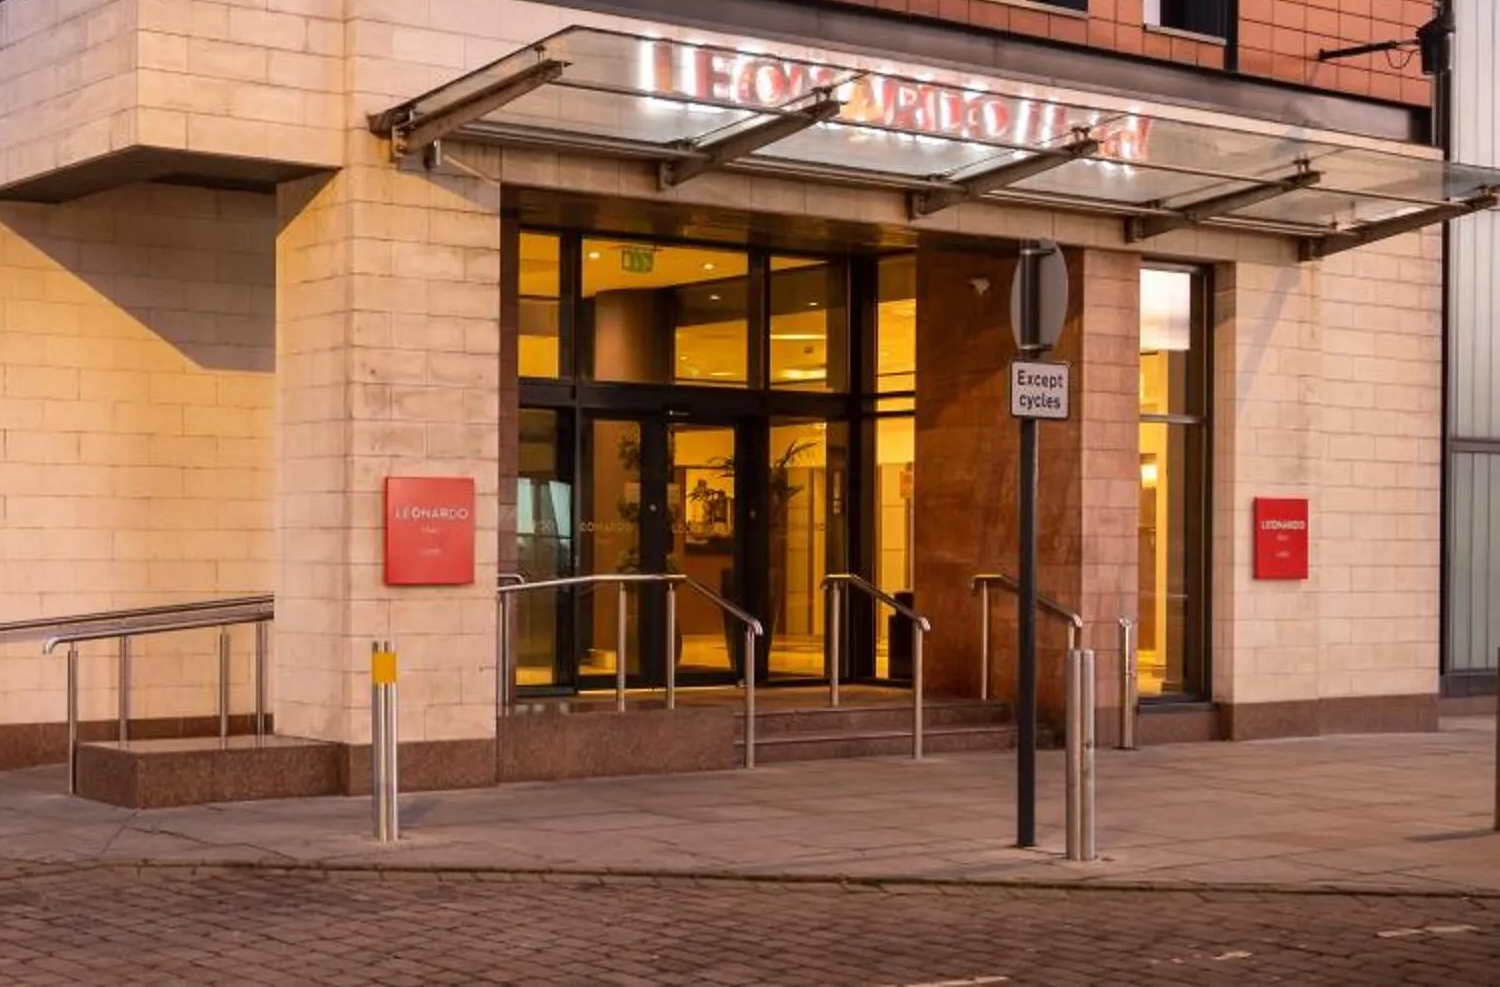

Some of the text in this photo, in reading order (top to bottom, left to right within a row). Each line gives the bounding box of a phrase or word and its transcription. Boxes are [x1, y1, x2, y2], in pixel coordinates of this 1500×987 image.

[1017, 369, 1064, 391] Except
[1019, 392, 1061, 410] cycles
[394, 505, 469, 521] LEONARDO
